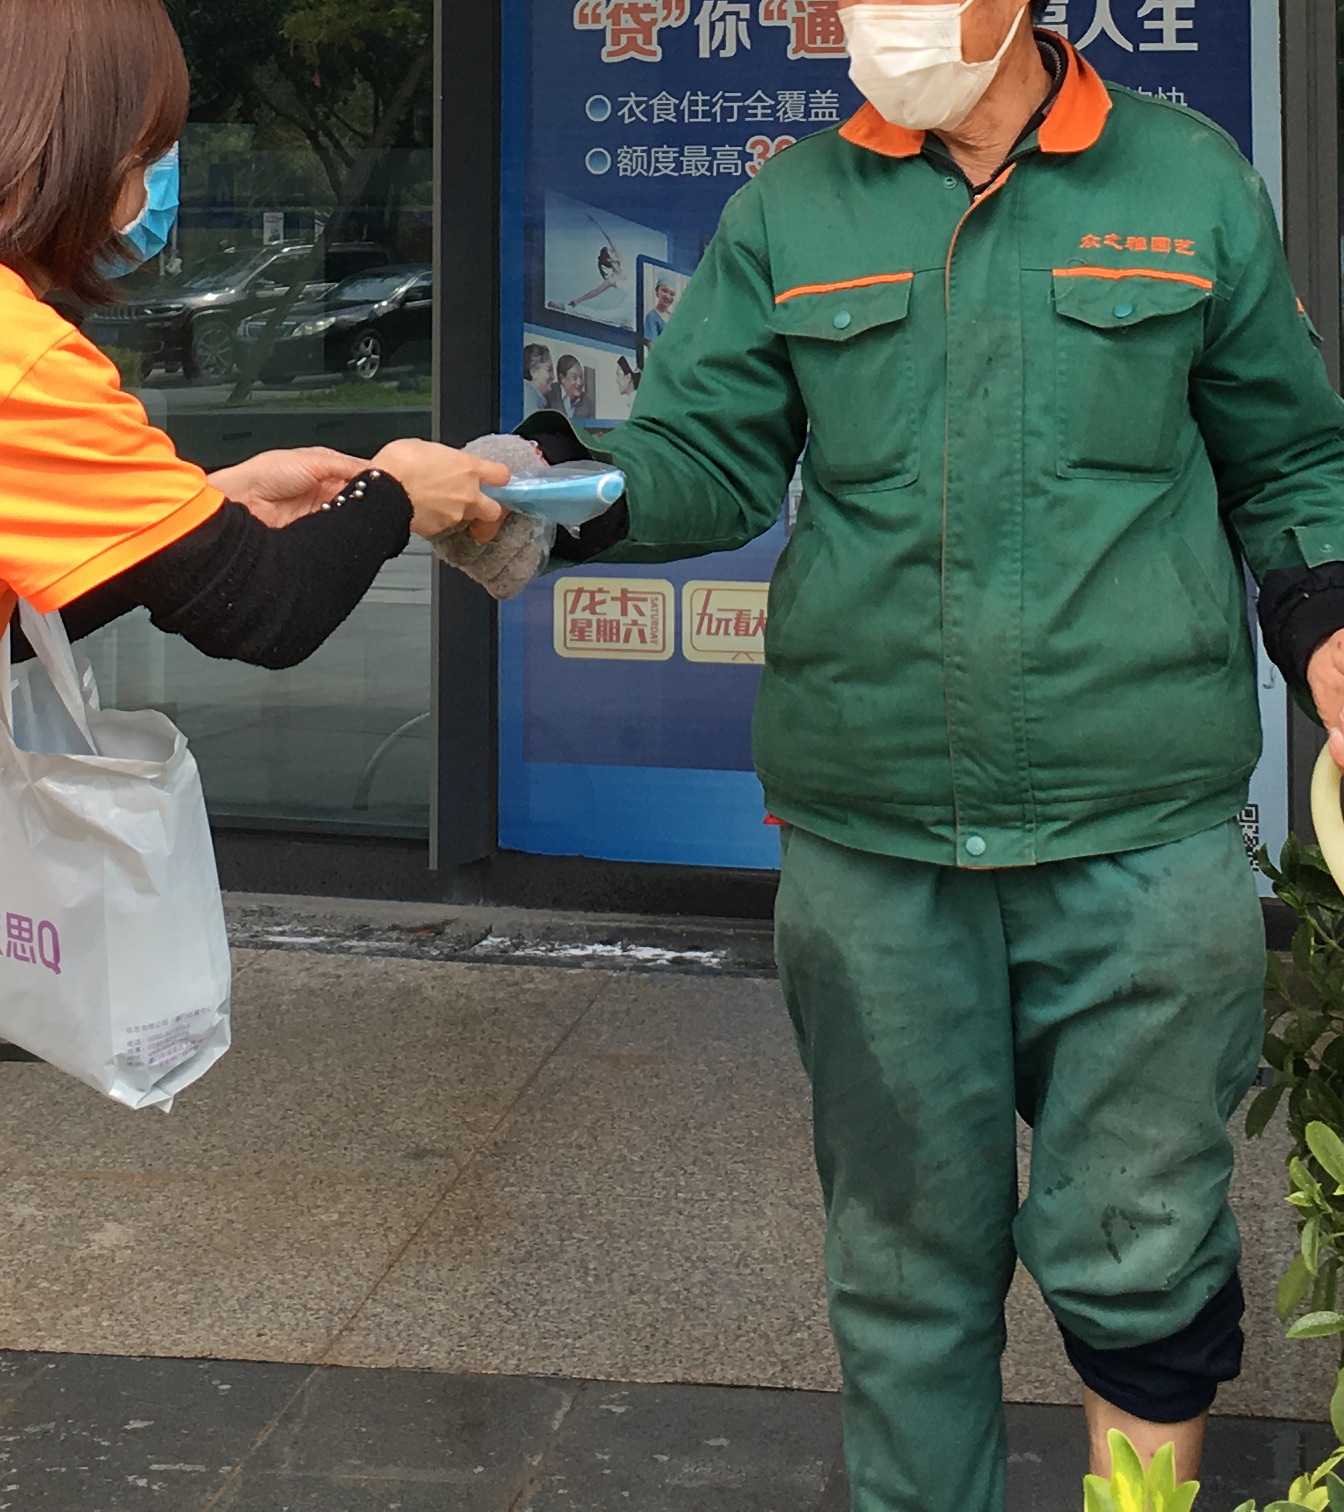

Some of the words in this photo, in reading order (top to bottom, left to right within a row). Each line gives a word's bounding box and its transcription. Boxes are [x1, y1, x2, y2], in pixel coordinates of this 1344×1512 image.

[616, 89, 841, 124] 衣食住行全覆盖
[568, 586, 649, 617] 龙卡
[568, 618, 649, 645] 星期六
